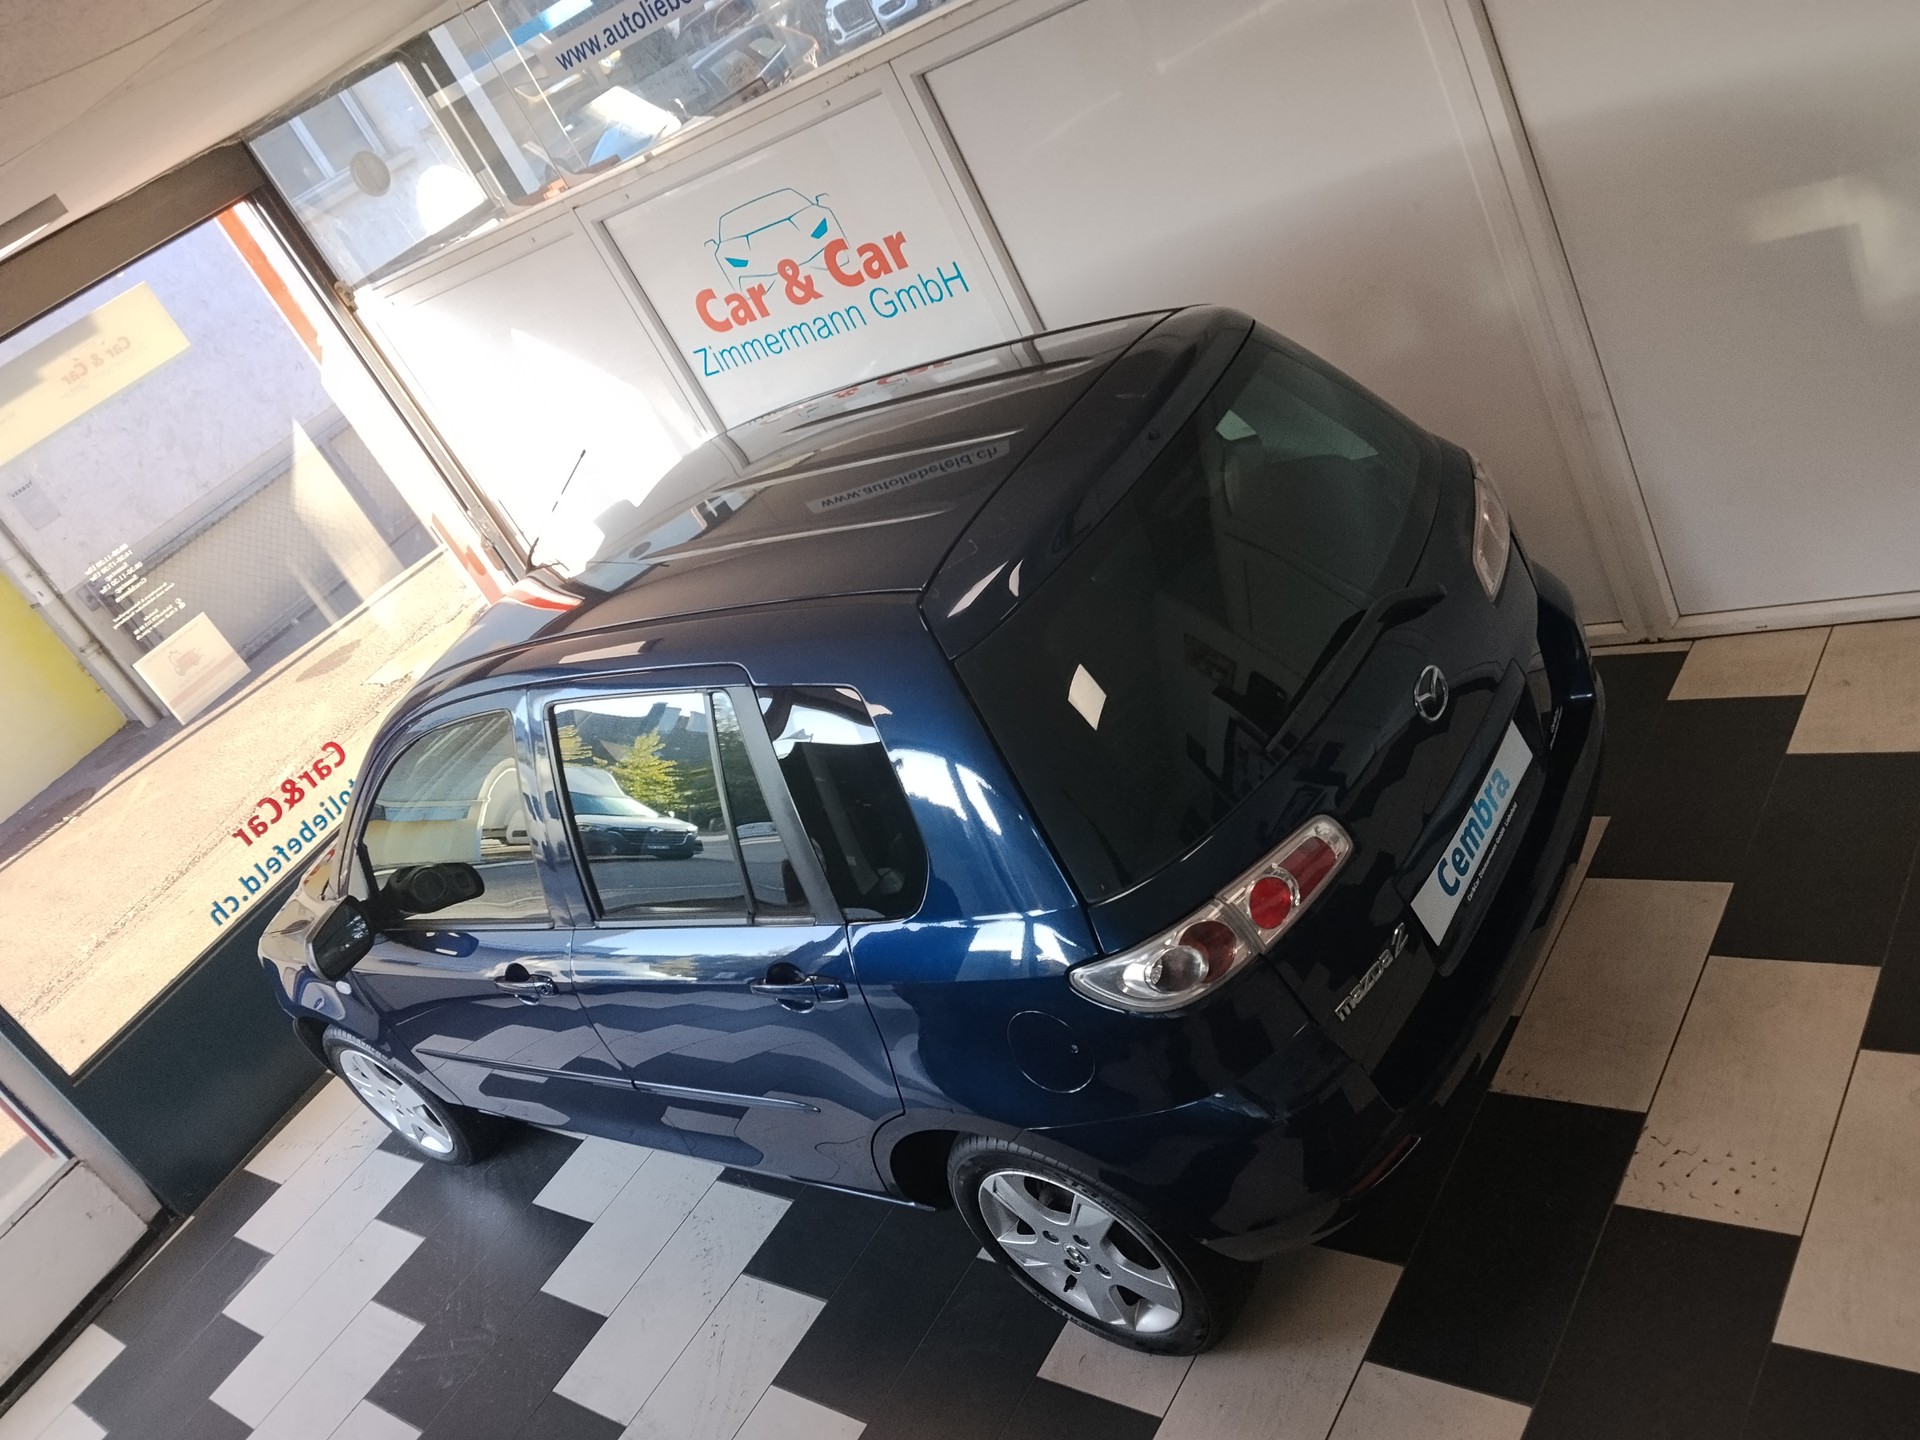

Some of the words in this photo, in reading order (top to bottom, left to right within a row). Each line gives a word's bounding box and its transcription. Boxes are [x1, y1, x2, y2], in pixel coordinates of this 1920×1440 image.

[693, 305, 867, 377] Zimmermann
[869, 261, 970, 318] GmbH
[695, 288, 771, 332] Car
[777, 258, 824, 305] &
[824, 231, 909, 287] Car
[1437, 768, 1510, 897] Cembra
